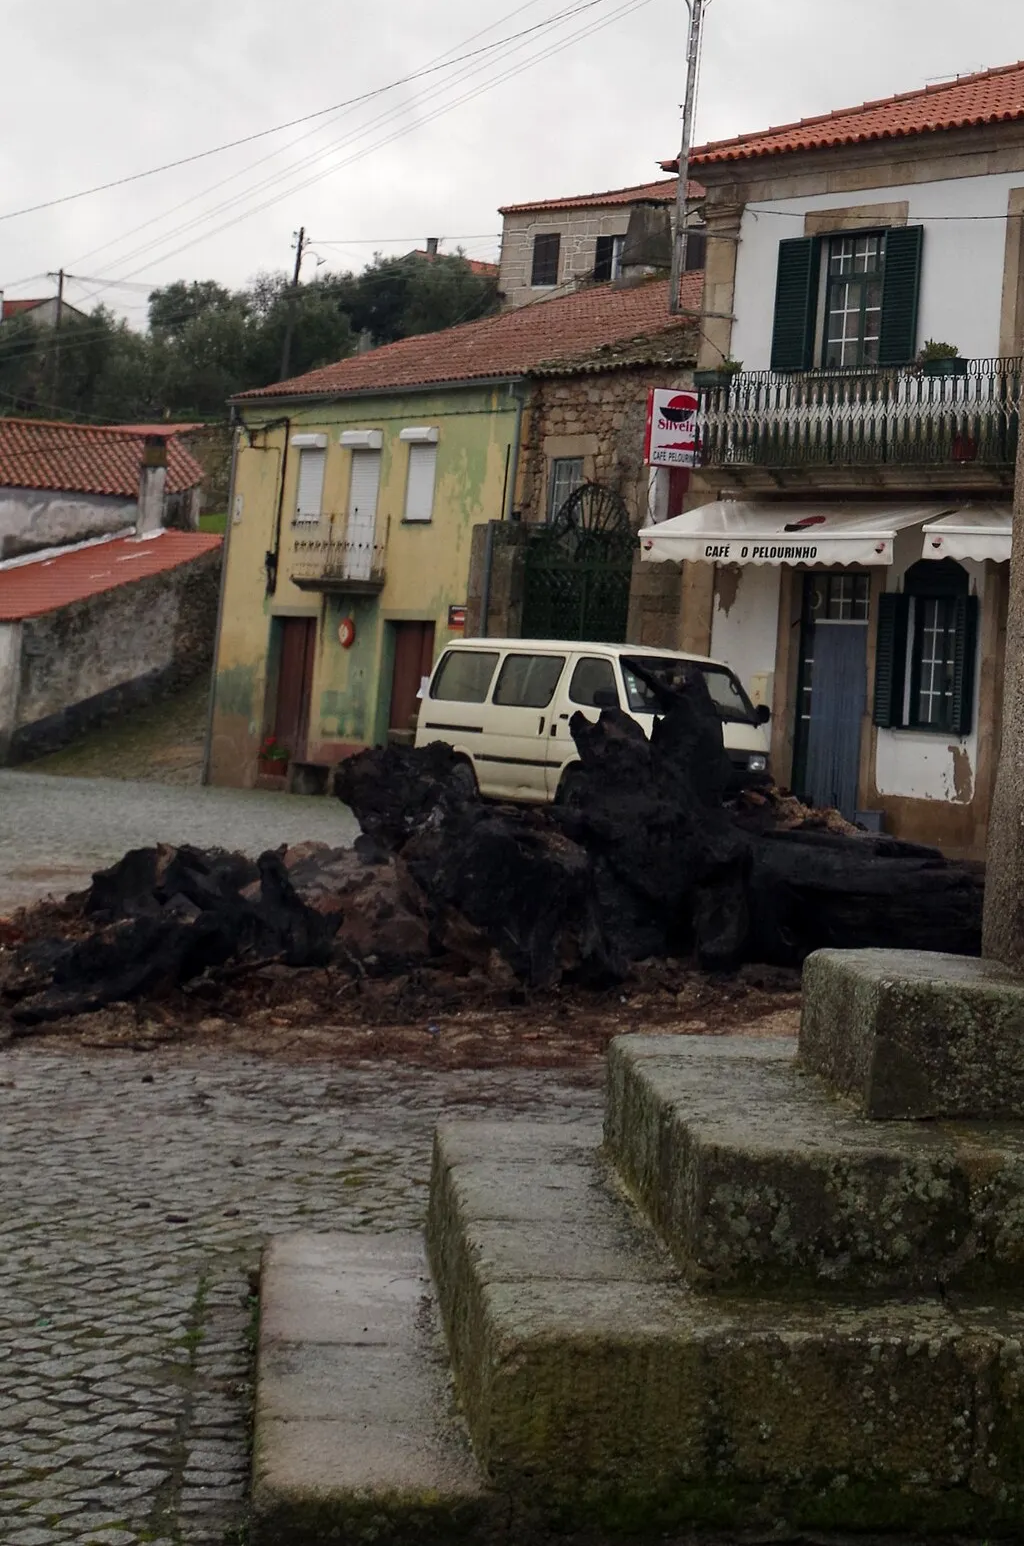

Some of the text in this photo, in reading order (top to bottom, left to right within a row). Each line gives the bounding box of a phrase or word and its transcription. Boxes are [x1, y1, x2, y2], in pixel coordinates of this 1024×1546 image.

[705, 544, 818, 559] CAFÉ O PELOURINHO
